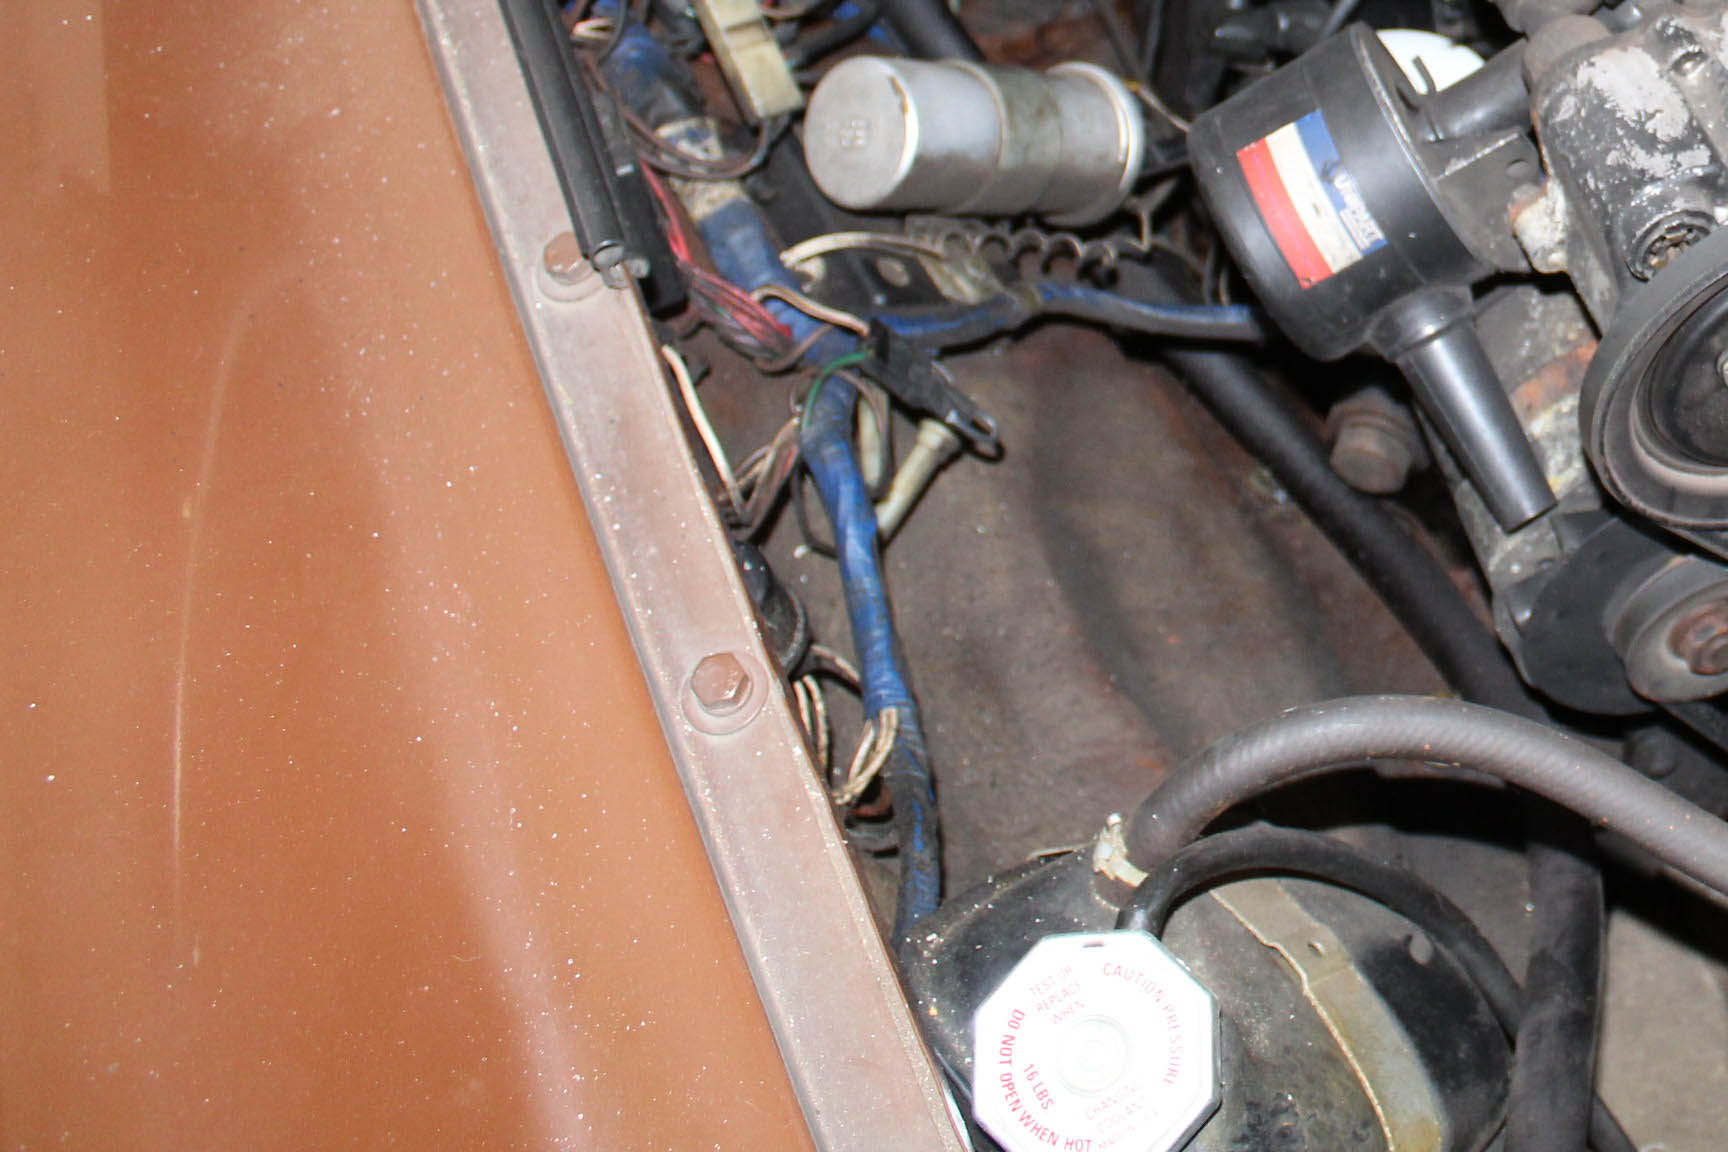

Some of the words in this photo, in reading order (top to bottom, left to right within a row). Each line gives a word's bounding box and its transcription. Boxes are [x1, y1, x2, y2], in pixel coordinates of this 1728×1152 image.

[1103, 962, 1163, 1003] CAUTION
[1006, 1008, 1027, 1031] DO
[998, 1033, 1017, 1066] NOT
[998, 1071, 1026, 1113] OPEN
[1023, 1062, 1039, 1082] 16
[1032, 1078, 1056, 1111] LBS
[1017, 1110, 1060, 1147] WHEN
[1063, 1137, 1092, 1152] HOT
